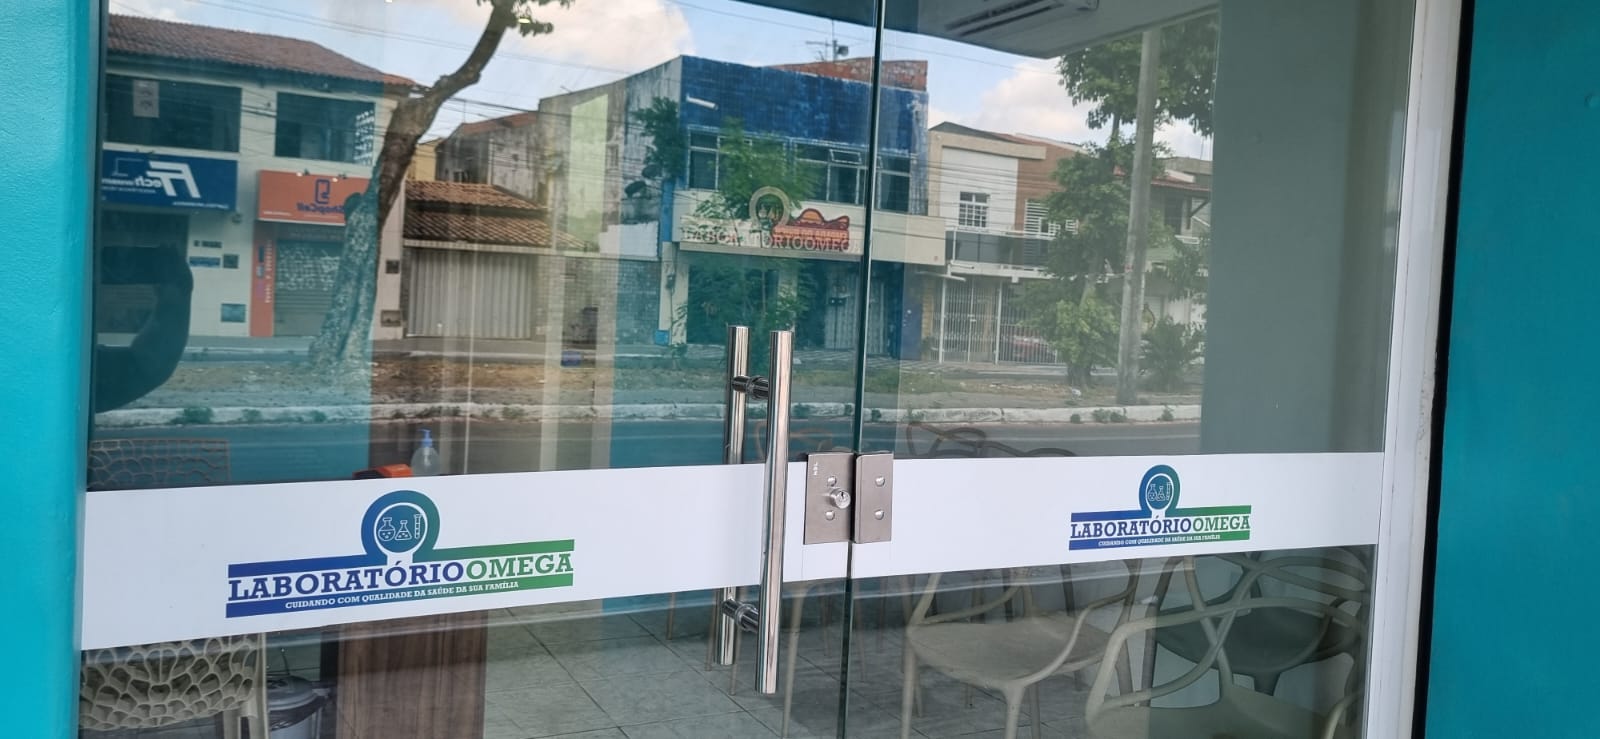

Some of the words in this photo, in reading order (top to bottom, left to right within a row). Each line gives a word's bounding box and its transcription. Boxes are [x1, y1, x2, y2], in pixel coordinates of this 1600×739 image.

[285, 595, 336, 609] CUIDANDO
[337, 594, 360, 605] COM
[361, 590, 413, 603] QUALIDADE
[413, 589, 426, 598] DA
[427, 585, 454, 596] SAÚDE
[455, 584, 467, 594] DA
[468, 583, 483, 592] SUA
[484, 579, 519, 591] FAMÍLIA
